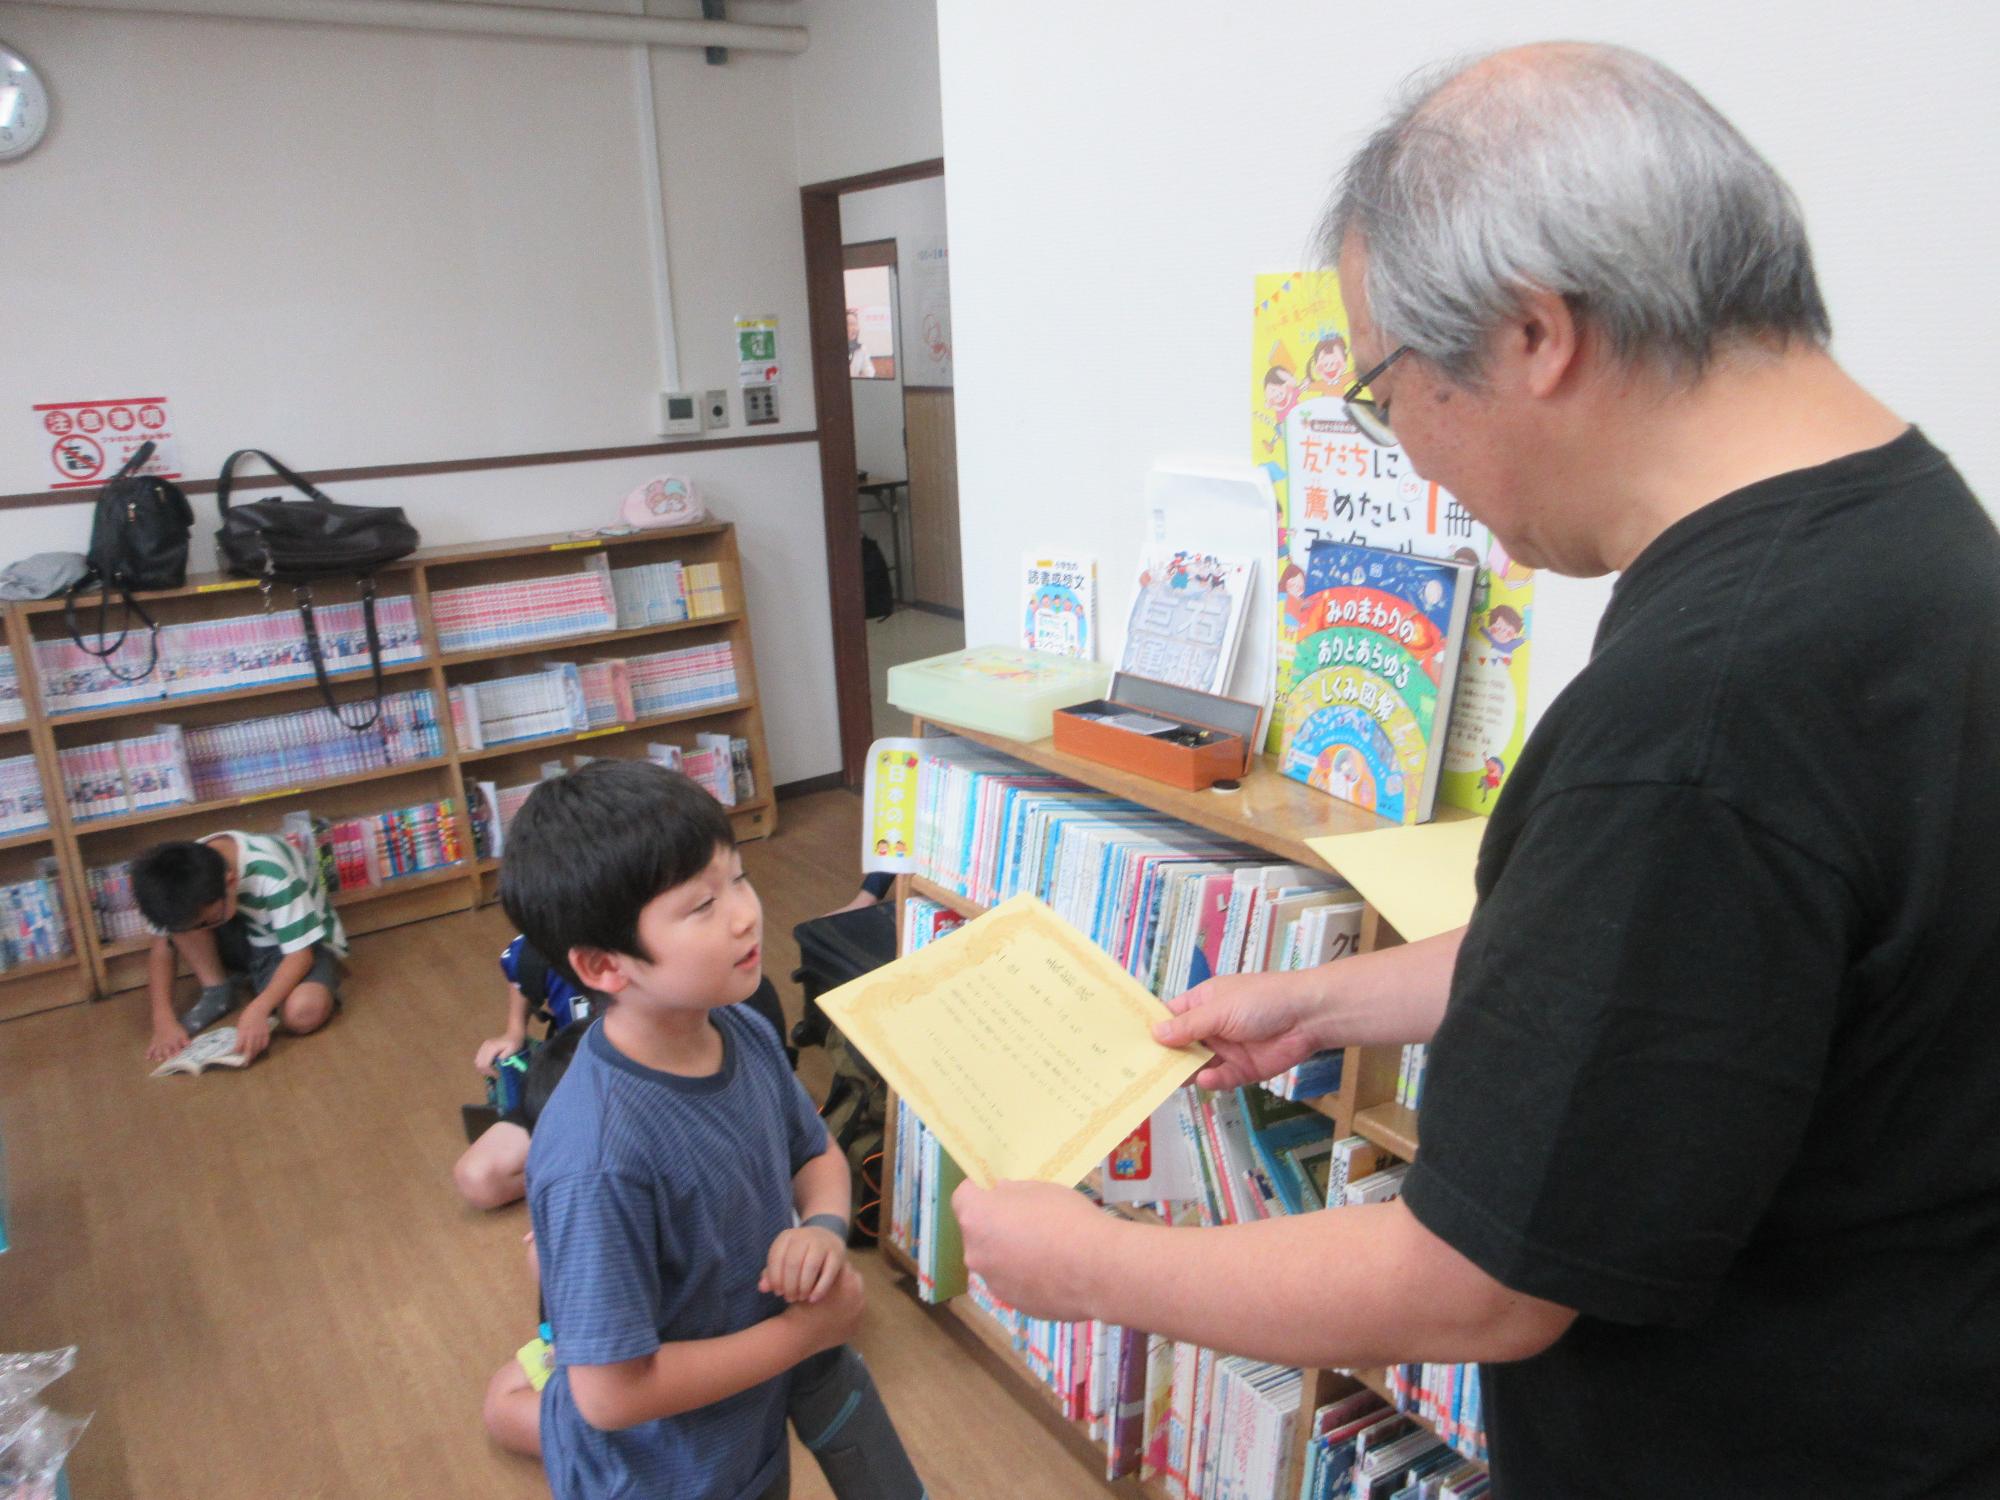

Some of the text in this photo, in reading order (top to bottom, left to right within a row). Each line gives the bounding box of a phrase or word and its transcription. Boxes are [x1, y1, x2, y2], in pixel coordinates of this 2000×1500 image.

[1299, 436, 1398, 478] 友だちに
[1303, 485, 1411, 528] 薦めたい
[1326, 596, 1415, 644] みのまわりの
[1318, 635, 1411, 690] ありとあらゆる
